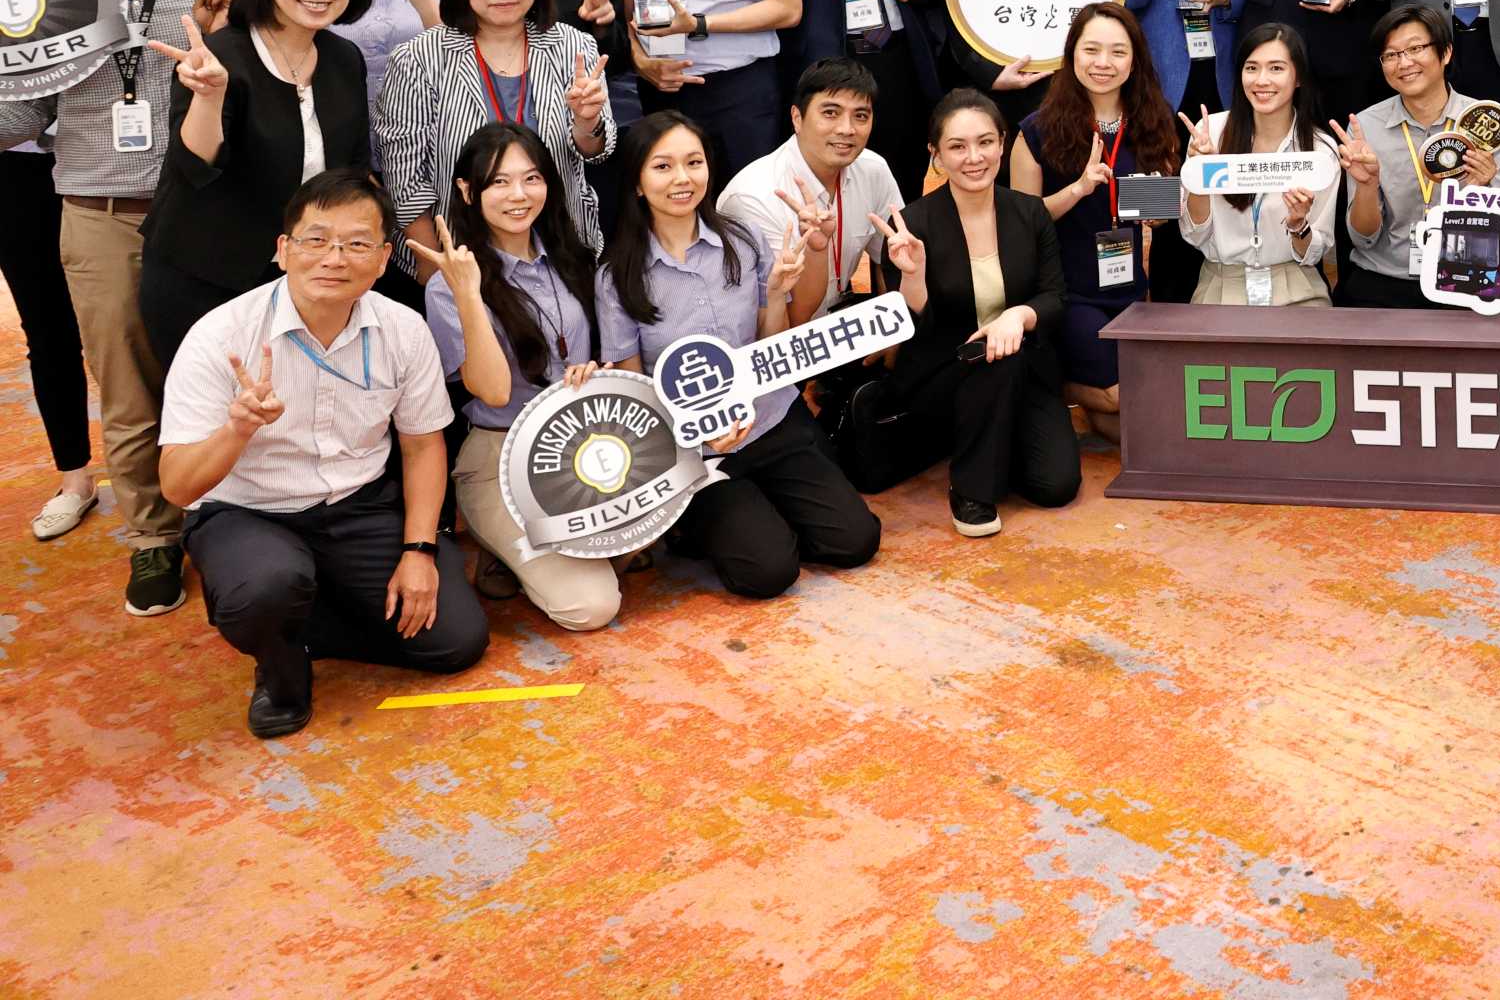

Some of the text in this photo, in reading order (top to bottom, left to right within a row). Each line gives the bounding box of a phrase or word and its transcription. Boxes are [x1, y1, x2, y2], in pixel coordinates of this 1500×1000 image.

[22, 62, 78, 88] WINNER
[1470, 122, 1494, 141] 100
[1237, 160, 1314, 173] 工業技術研究院
[1425, 142, 1442, 162] EDISON
[751, 303, 906, 385] 船舶中心
[680, 402, 750, 443] SOIC
[1184, 364, 1337, 443] ECO
[533, 398, 660, 475] EDISON AWARDS
[567, 478, 677, 535] SILVER
[587, 508, 669, 547] 2025 WINNER
